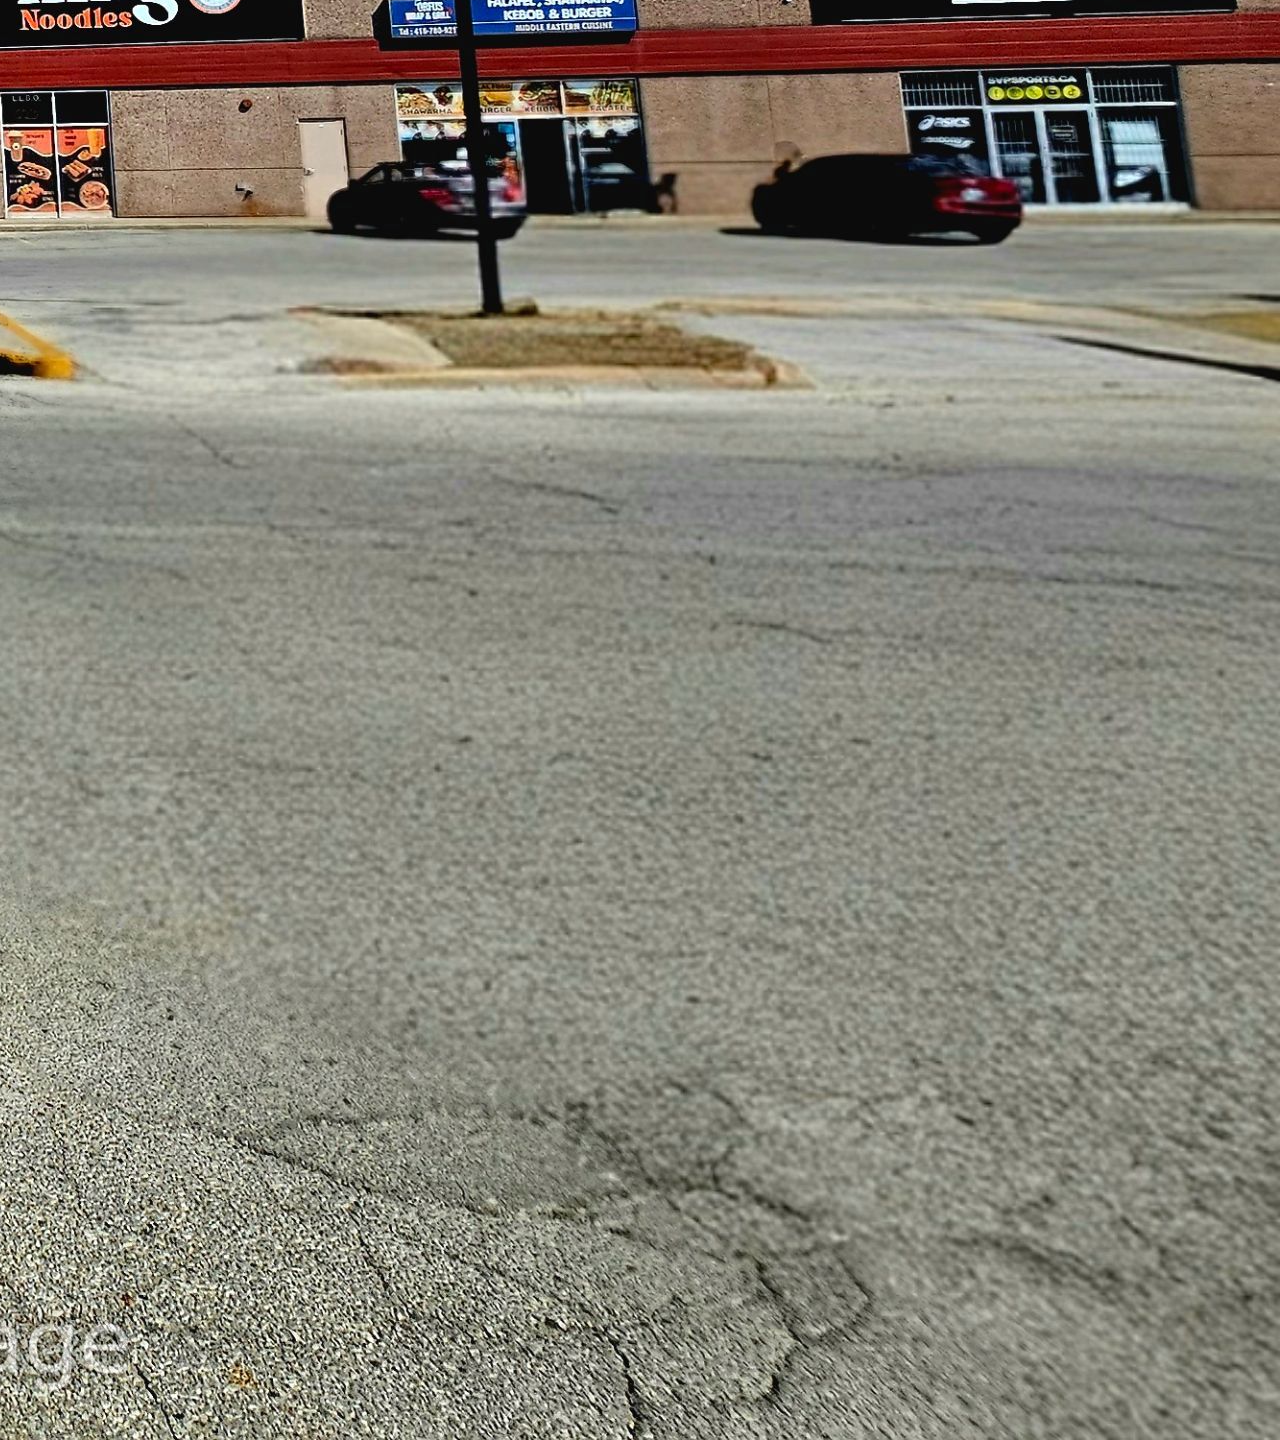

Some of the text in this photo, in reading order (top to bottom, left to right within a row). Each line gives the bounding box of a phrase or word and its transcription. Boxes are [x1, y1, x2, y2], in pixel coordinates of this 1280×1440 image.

[18, 8, 133, 31] Noodles
[503, 6, 613, 21] KEBOB & BURGER
[515, 21, 613, 32] MIDDLE EASTERN CUISINE
